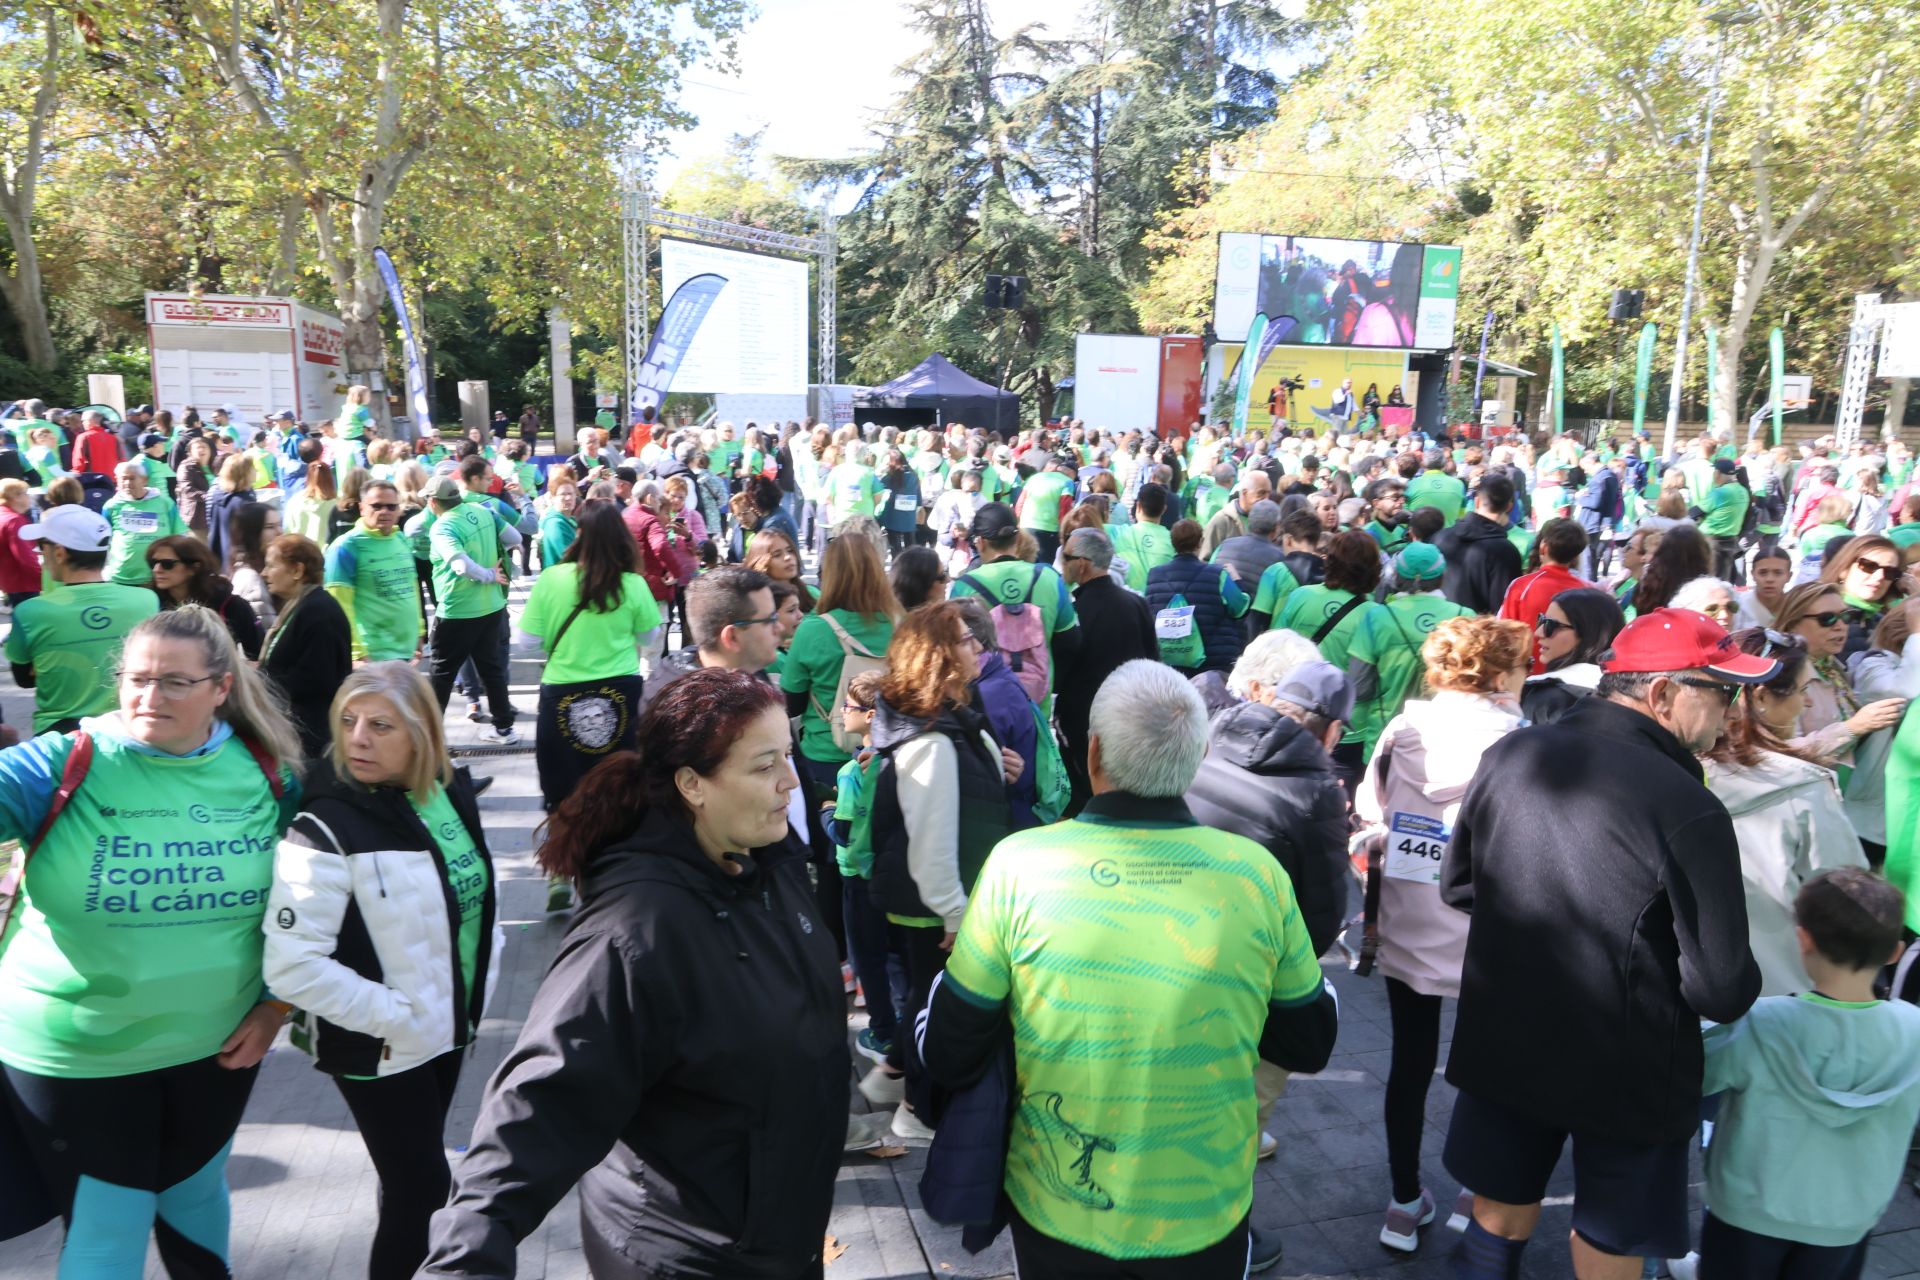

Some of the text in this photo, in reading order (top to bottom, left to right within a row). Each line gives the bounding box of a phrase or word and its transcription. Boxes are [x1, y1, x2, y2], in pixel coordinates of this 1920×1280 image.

[111, 833, 271, 858] En marcha
[84, 835, 108, 912] VALLADOLID
[107, 863, 225, 886] contra
[103, 886, 271, 913] el cáncer
